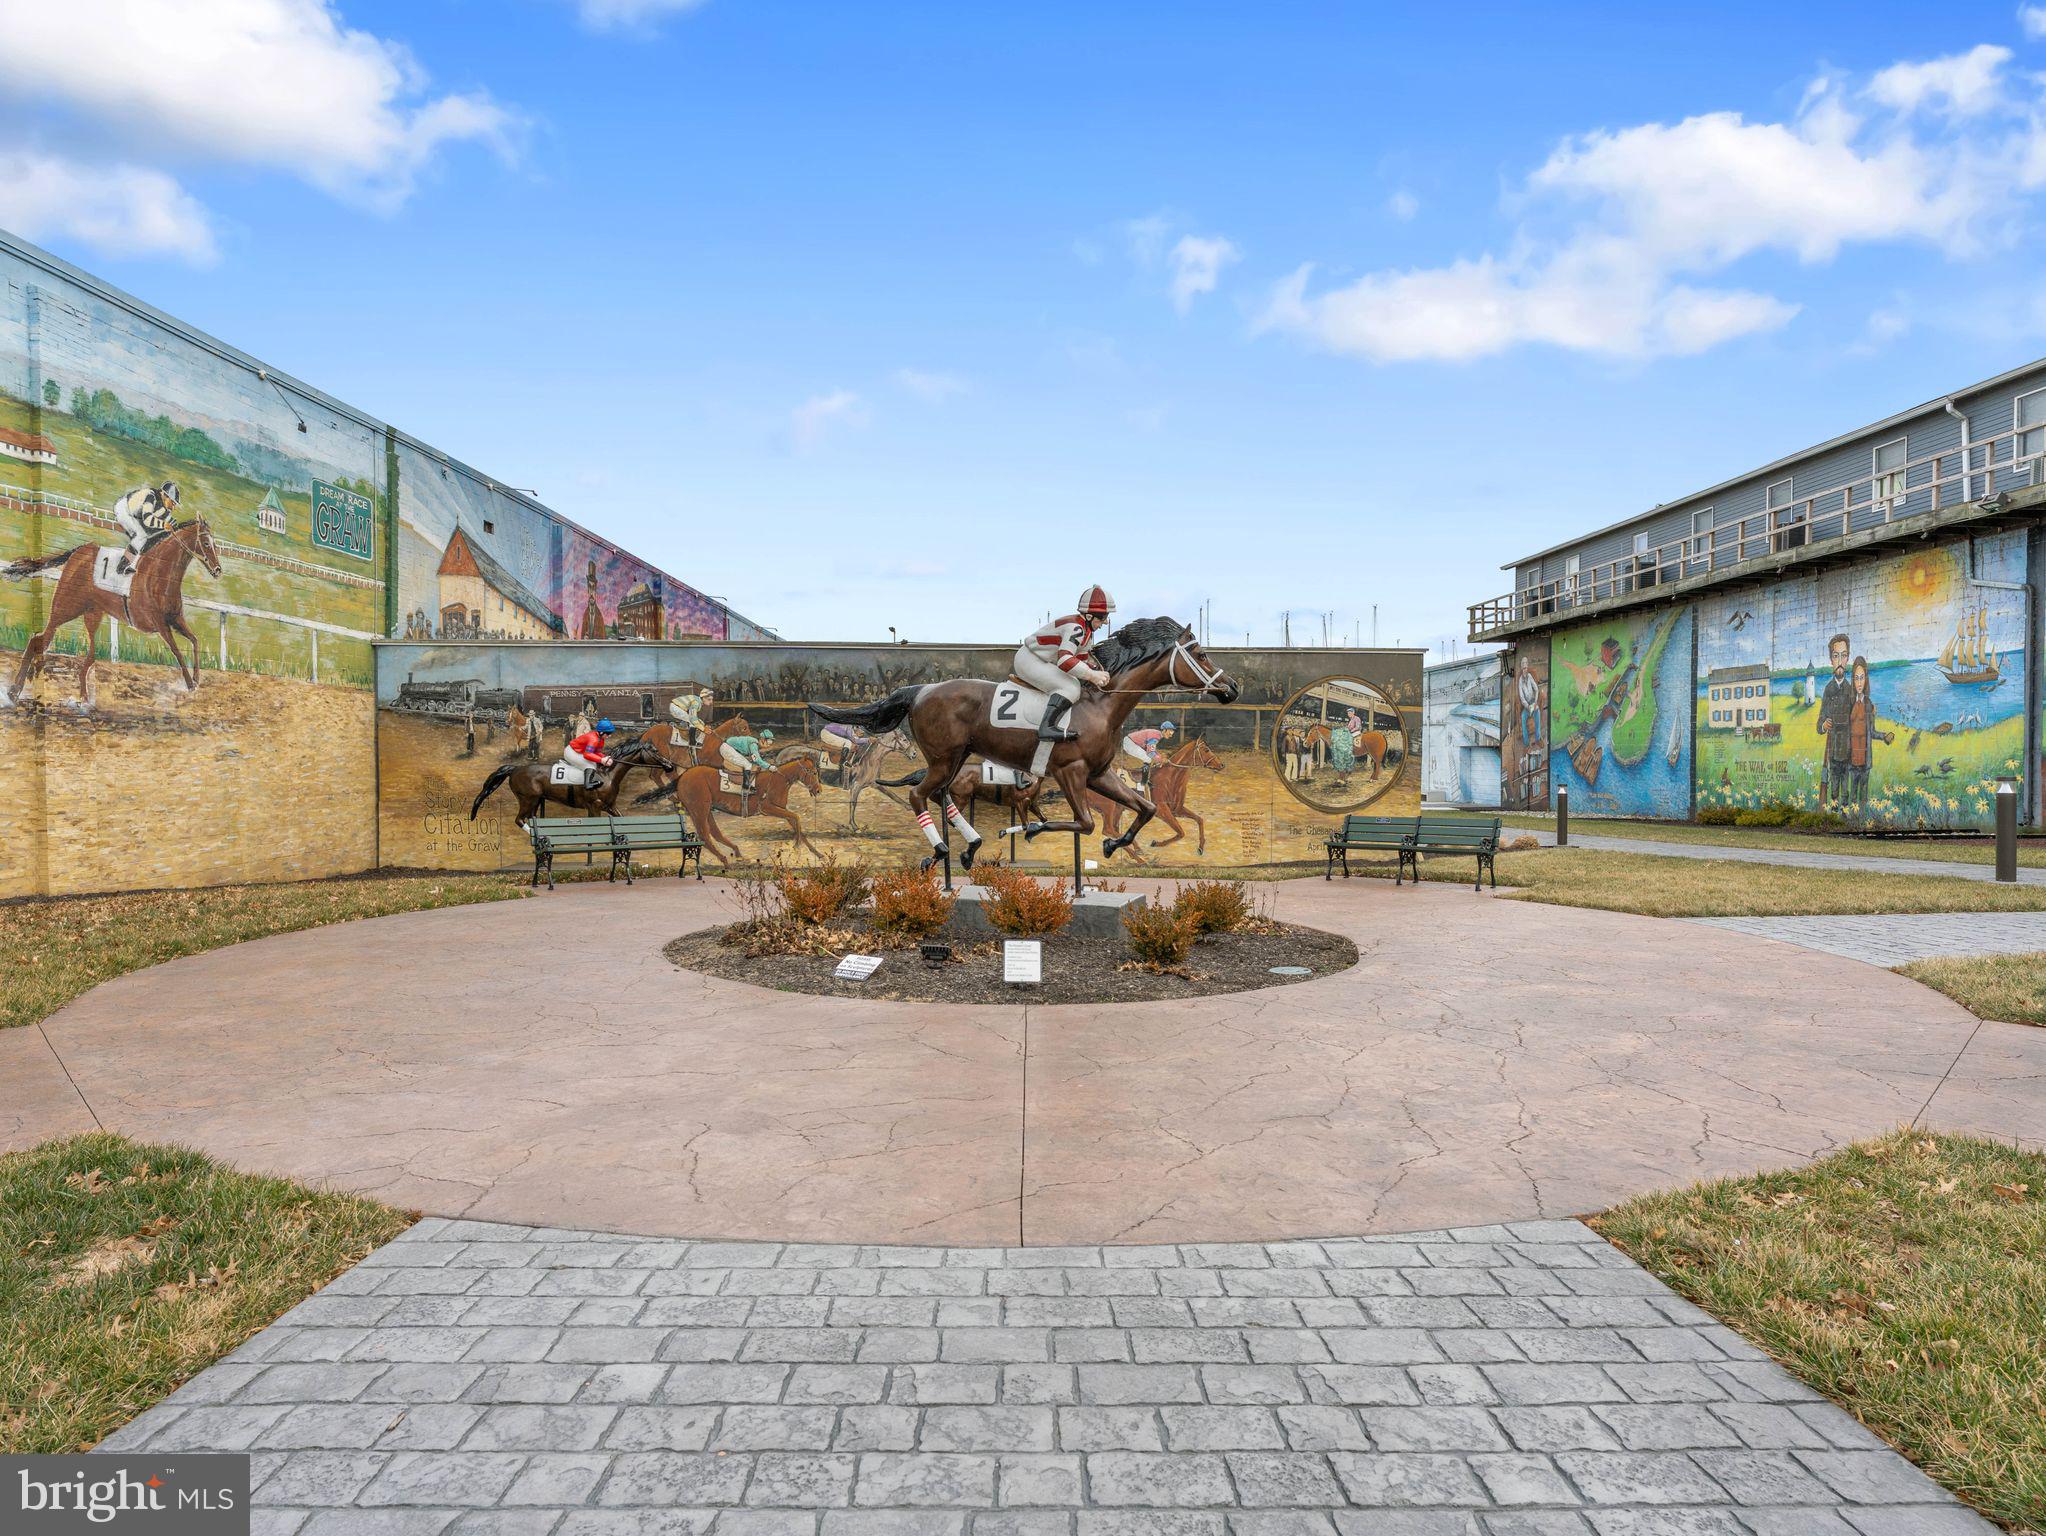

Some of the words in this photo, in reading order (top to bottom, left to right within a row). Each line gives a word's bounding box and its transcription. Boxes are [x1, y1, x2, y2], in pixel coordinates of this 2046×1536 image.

[320, 487, 345, 502] DREAM
[347, 495, 368, 510] RACE
[316, 502, 372, 553] GRAW
[103, 556, 109, 580] 1
[1069, 626, 1084, 647] 2
[997, 689, 1020, 720] 2
[674, 732, 680, 743] 1
[821, 756, 829, 766] 4
[556, 767, 565, 780] 6
[988, 766, 994, 781] 1
[721, 780, 730, 790] 3
[425, 791, 467, 813] Story
[424, 813, 500, 834] Citation
[426, 839, 438, 851] at
[446, 838, 463, 851] the
[468, 839, 500, 852] Graw
